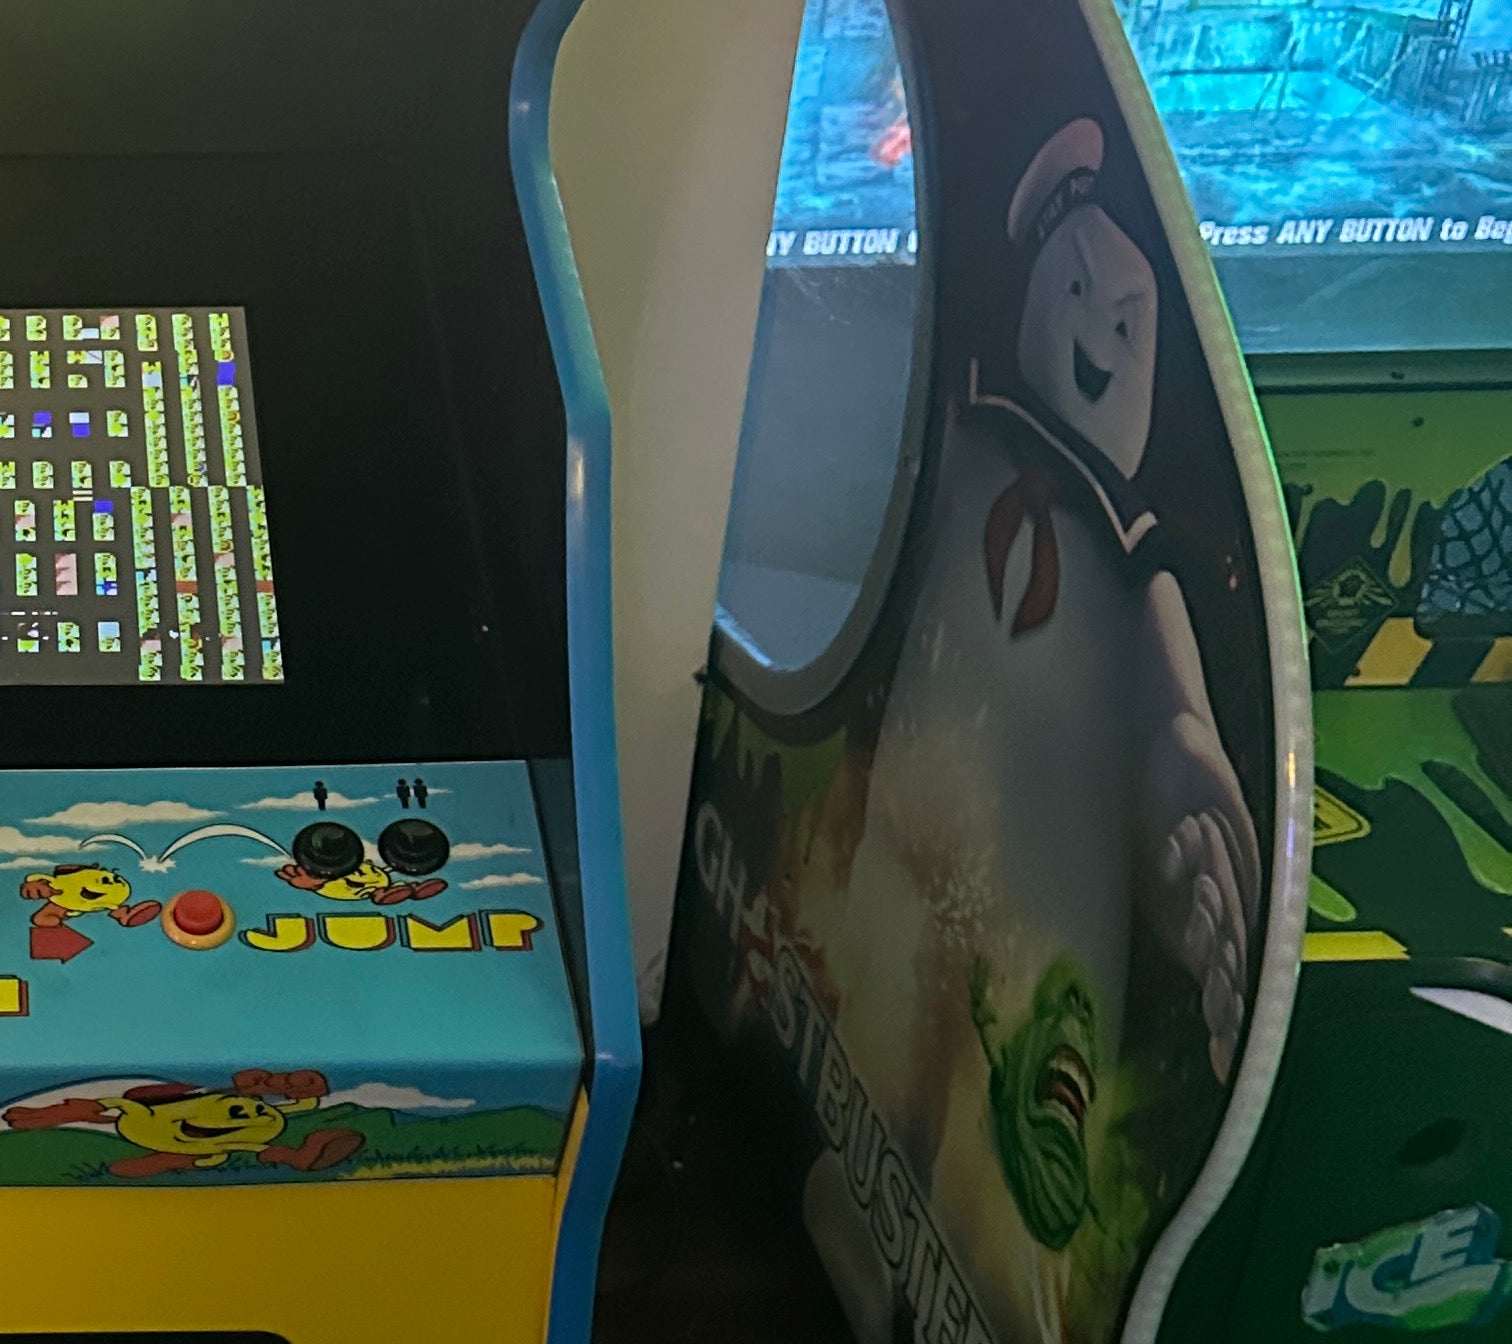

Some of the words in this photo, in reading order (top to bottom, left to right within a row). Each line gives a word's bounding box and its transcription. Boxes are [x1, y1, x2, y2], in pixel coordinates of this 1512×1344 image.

[803, 228, 900, 255] BUTTON
[1199, 220, 1270, 246] Press
[1276, 218, 1334, 244] ANY
[1339, 216, 1435, 243] BUTTON
[1440, 217, 1469, 241] to
[237, 909, 543, 953] JUMP
[1301, 1204, 1502, 1319] ICE
